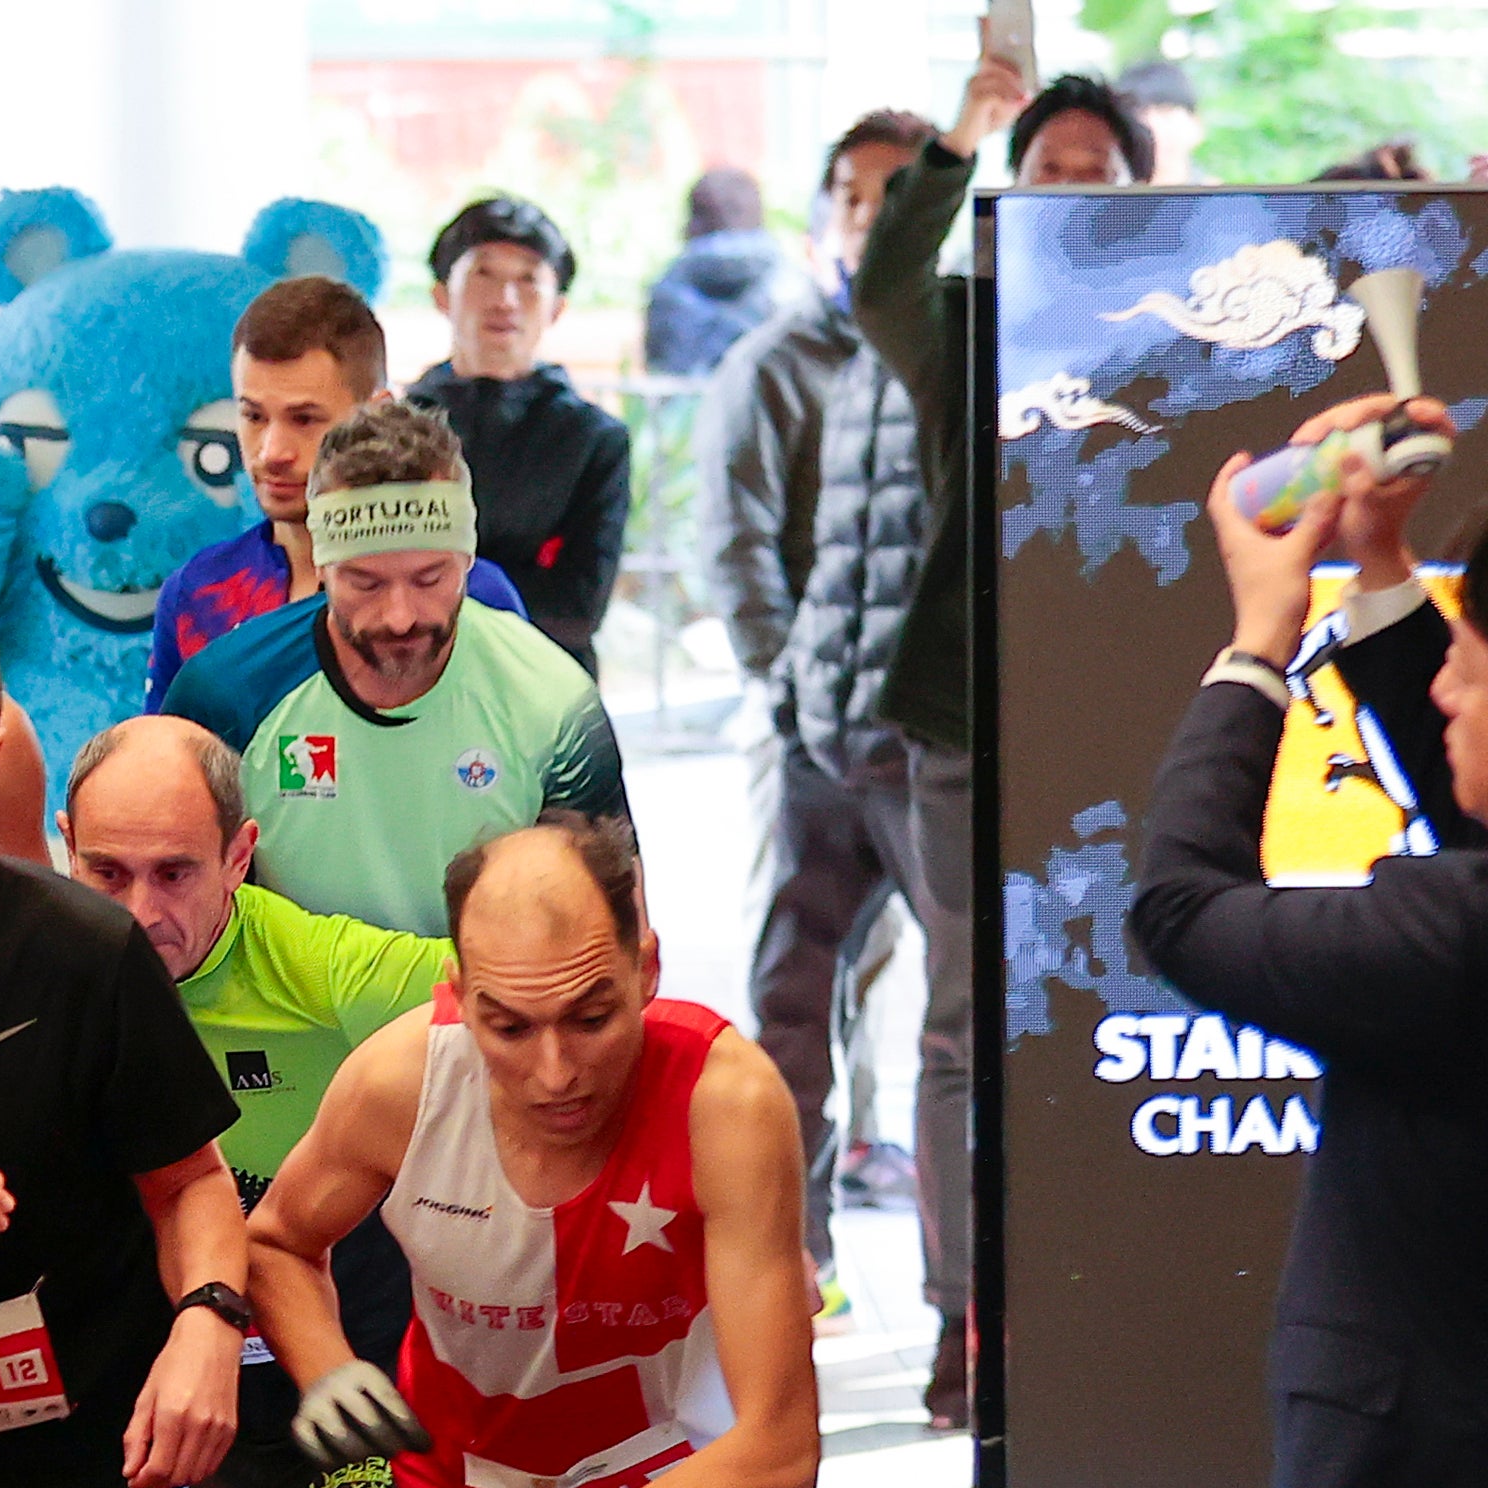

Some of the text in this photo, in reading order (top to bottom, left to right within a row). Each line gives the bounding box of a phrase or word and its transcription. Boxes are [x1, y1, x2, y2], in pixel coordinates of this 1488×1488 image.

[321, 499, 451, 531] PORTUGAL
[235, 1070, 284, 1089] AMS
[412, 1195, 493, 1221] JOGGING
[5, 1357, 39, 1383] 12
